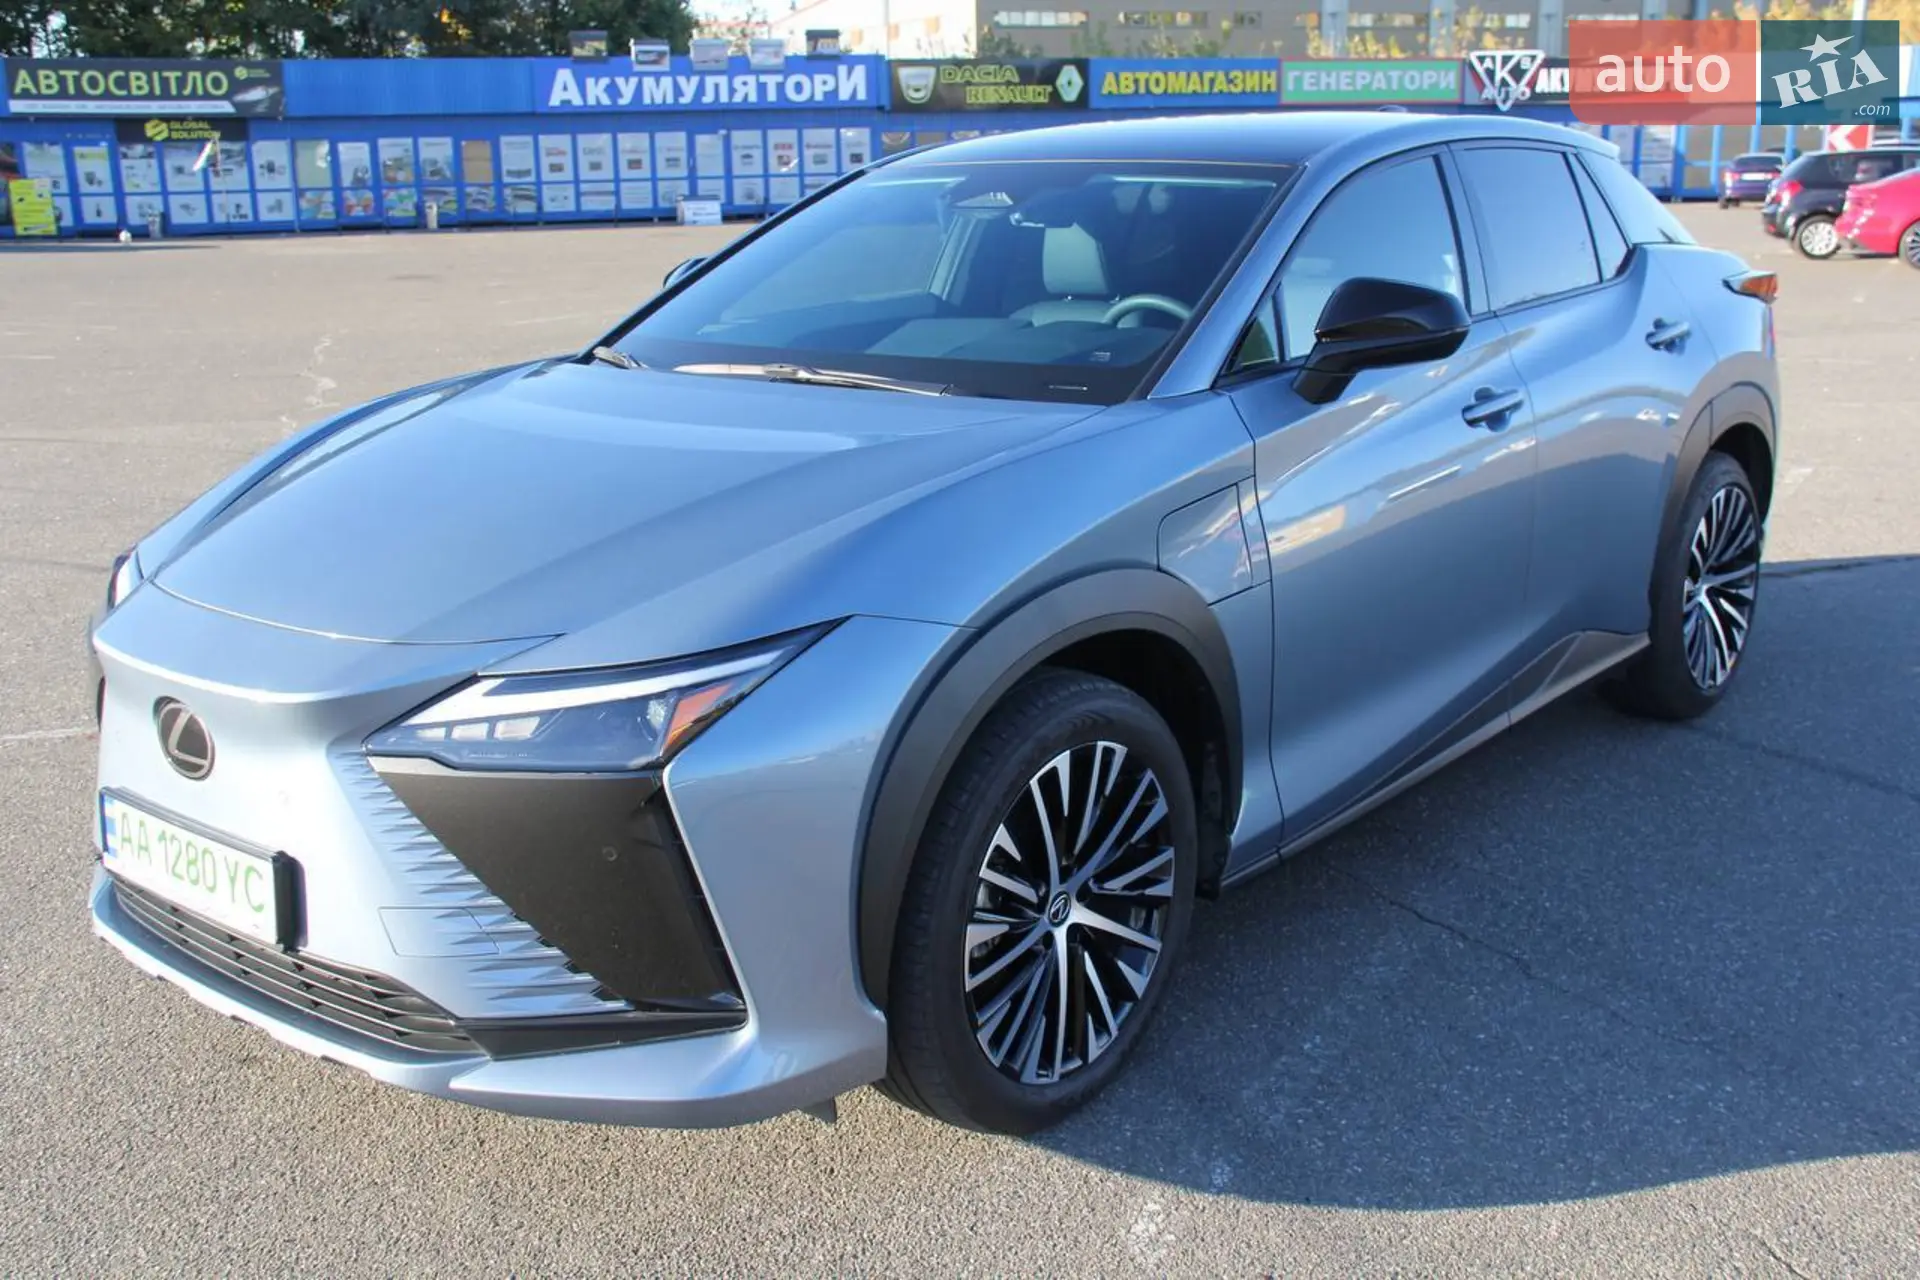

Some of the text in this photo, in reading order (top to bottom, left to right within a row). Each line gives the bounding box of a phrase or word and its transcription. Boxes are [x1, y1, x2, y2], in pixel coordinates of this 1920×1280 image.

[14, 69, 229, 96] АВТОСВІТЛО
[548, 64, 867, 107] АКУМУЛЯТОРИ
[940, 65, 1020, 83] DACIA
[1102, 70, 1277, 95] АВТОМАГАЗИН
[1287, 69, 1456, 92] ГЕНЕРАТОРИ
[966, 85, 1053, 104] RENAULT
[170, 121, 211, 130] GLOBAL
[170, 131, 221, 140] SOLUTION
[120, 811, 264, 913] AA 1280 YC
